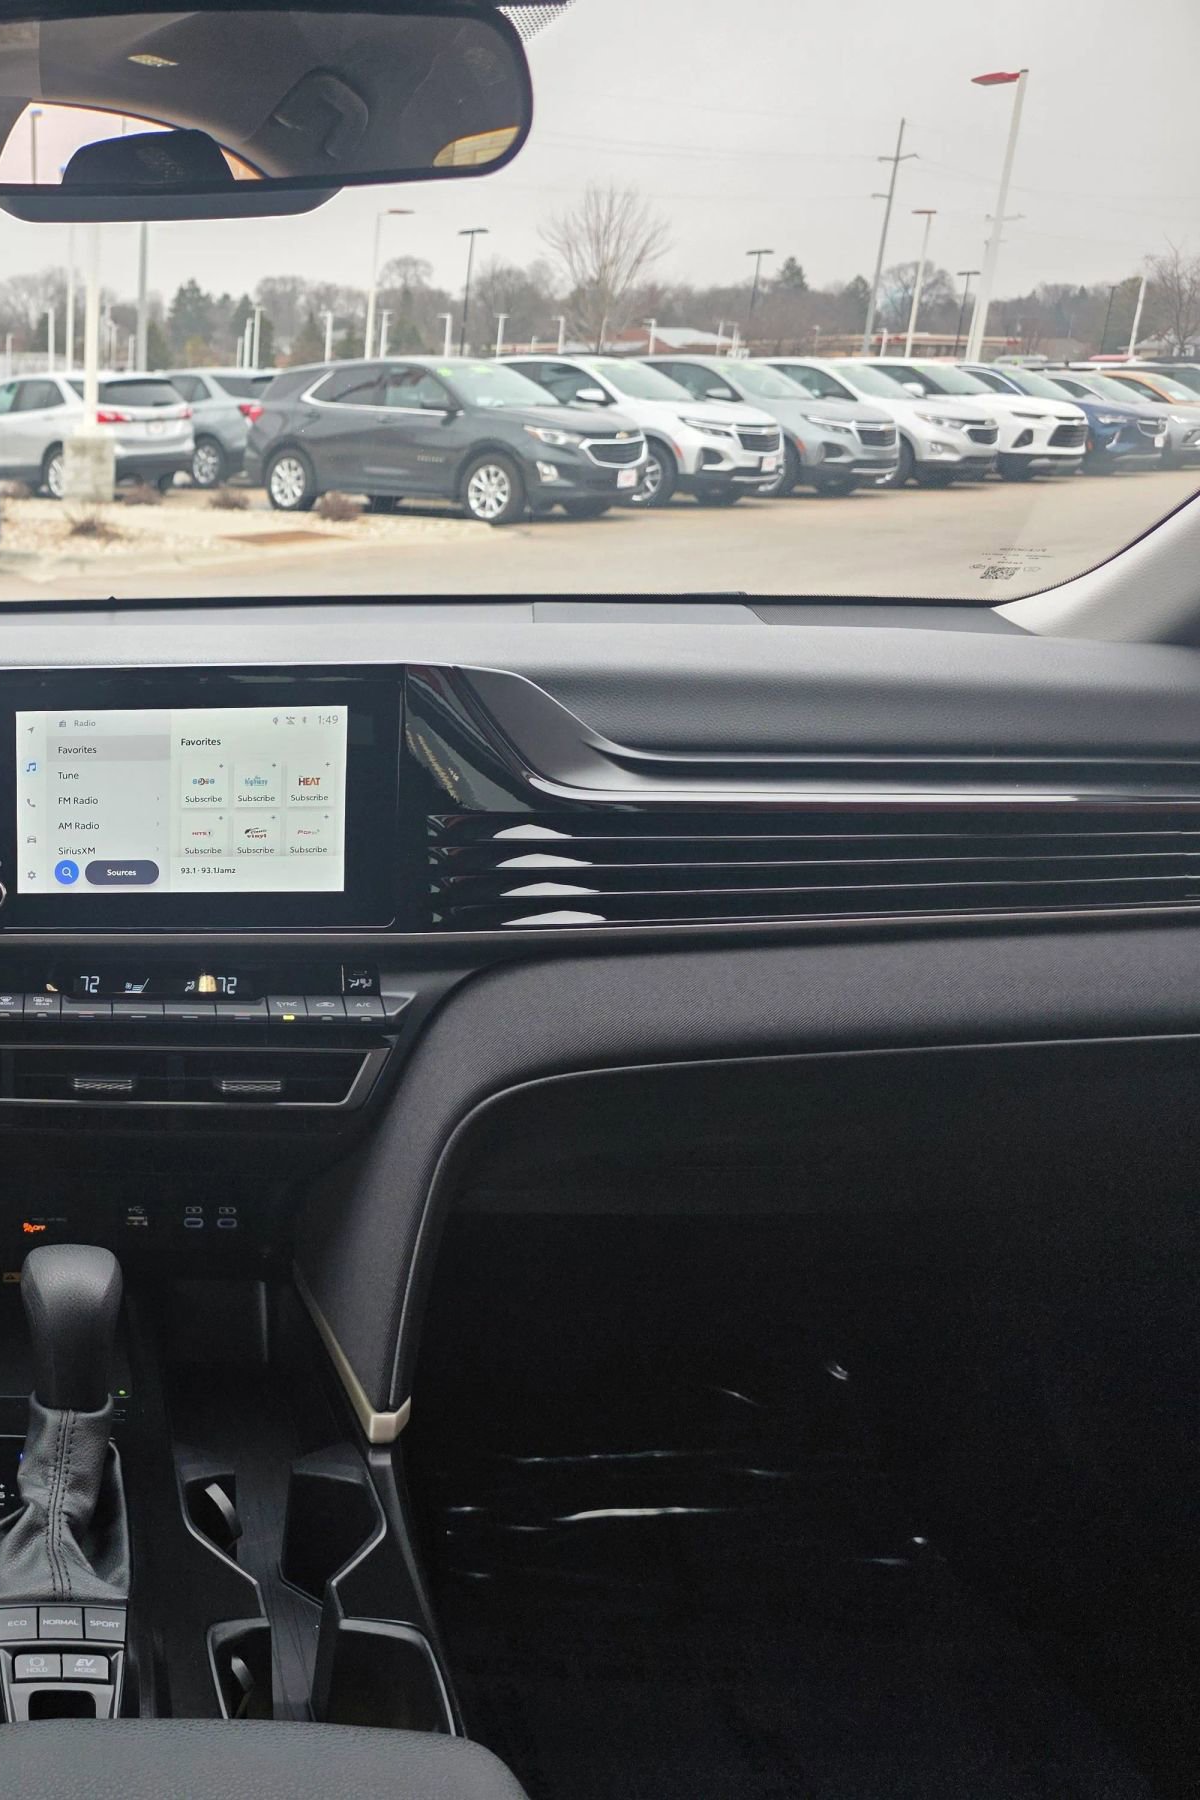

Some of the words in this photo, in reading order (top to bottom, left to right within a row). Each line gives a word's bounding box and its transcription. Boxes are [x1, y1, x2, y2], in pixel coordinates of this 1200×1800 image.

[318, 715, 338, 724] 1:49
[181, 738, 221, 746] Favorites
[58, 746, 97, 754] Favorites
[58, 772, 79, 780] Tune
[298, 777, 321, 786] HEAT
[58, 797, 71, 805] FM
[73, 796, 98, 805] Radio
[185, 795, 222, 803] Subscribe
[291, 794, 328, 802] Subscribe
[58, 822, 72, 830] AM
[74, 822, 100, 830] Radio
[58, 847, 96, 855] SiriusXM
[185, 847, 222, 855] Subscribe
[290, 846, 327, 854] Subscribe
[80, 975, 100, 993] 72
[216, 976, 238, 994] 72
[89, 1620, 120, 1628] SPORT
[75, 1658, 95, 1666] EV
